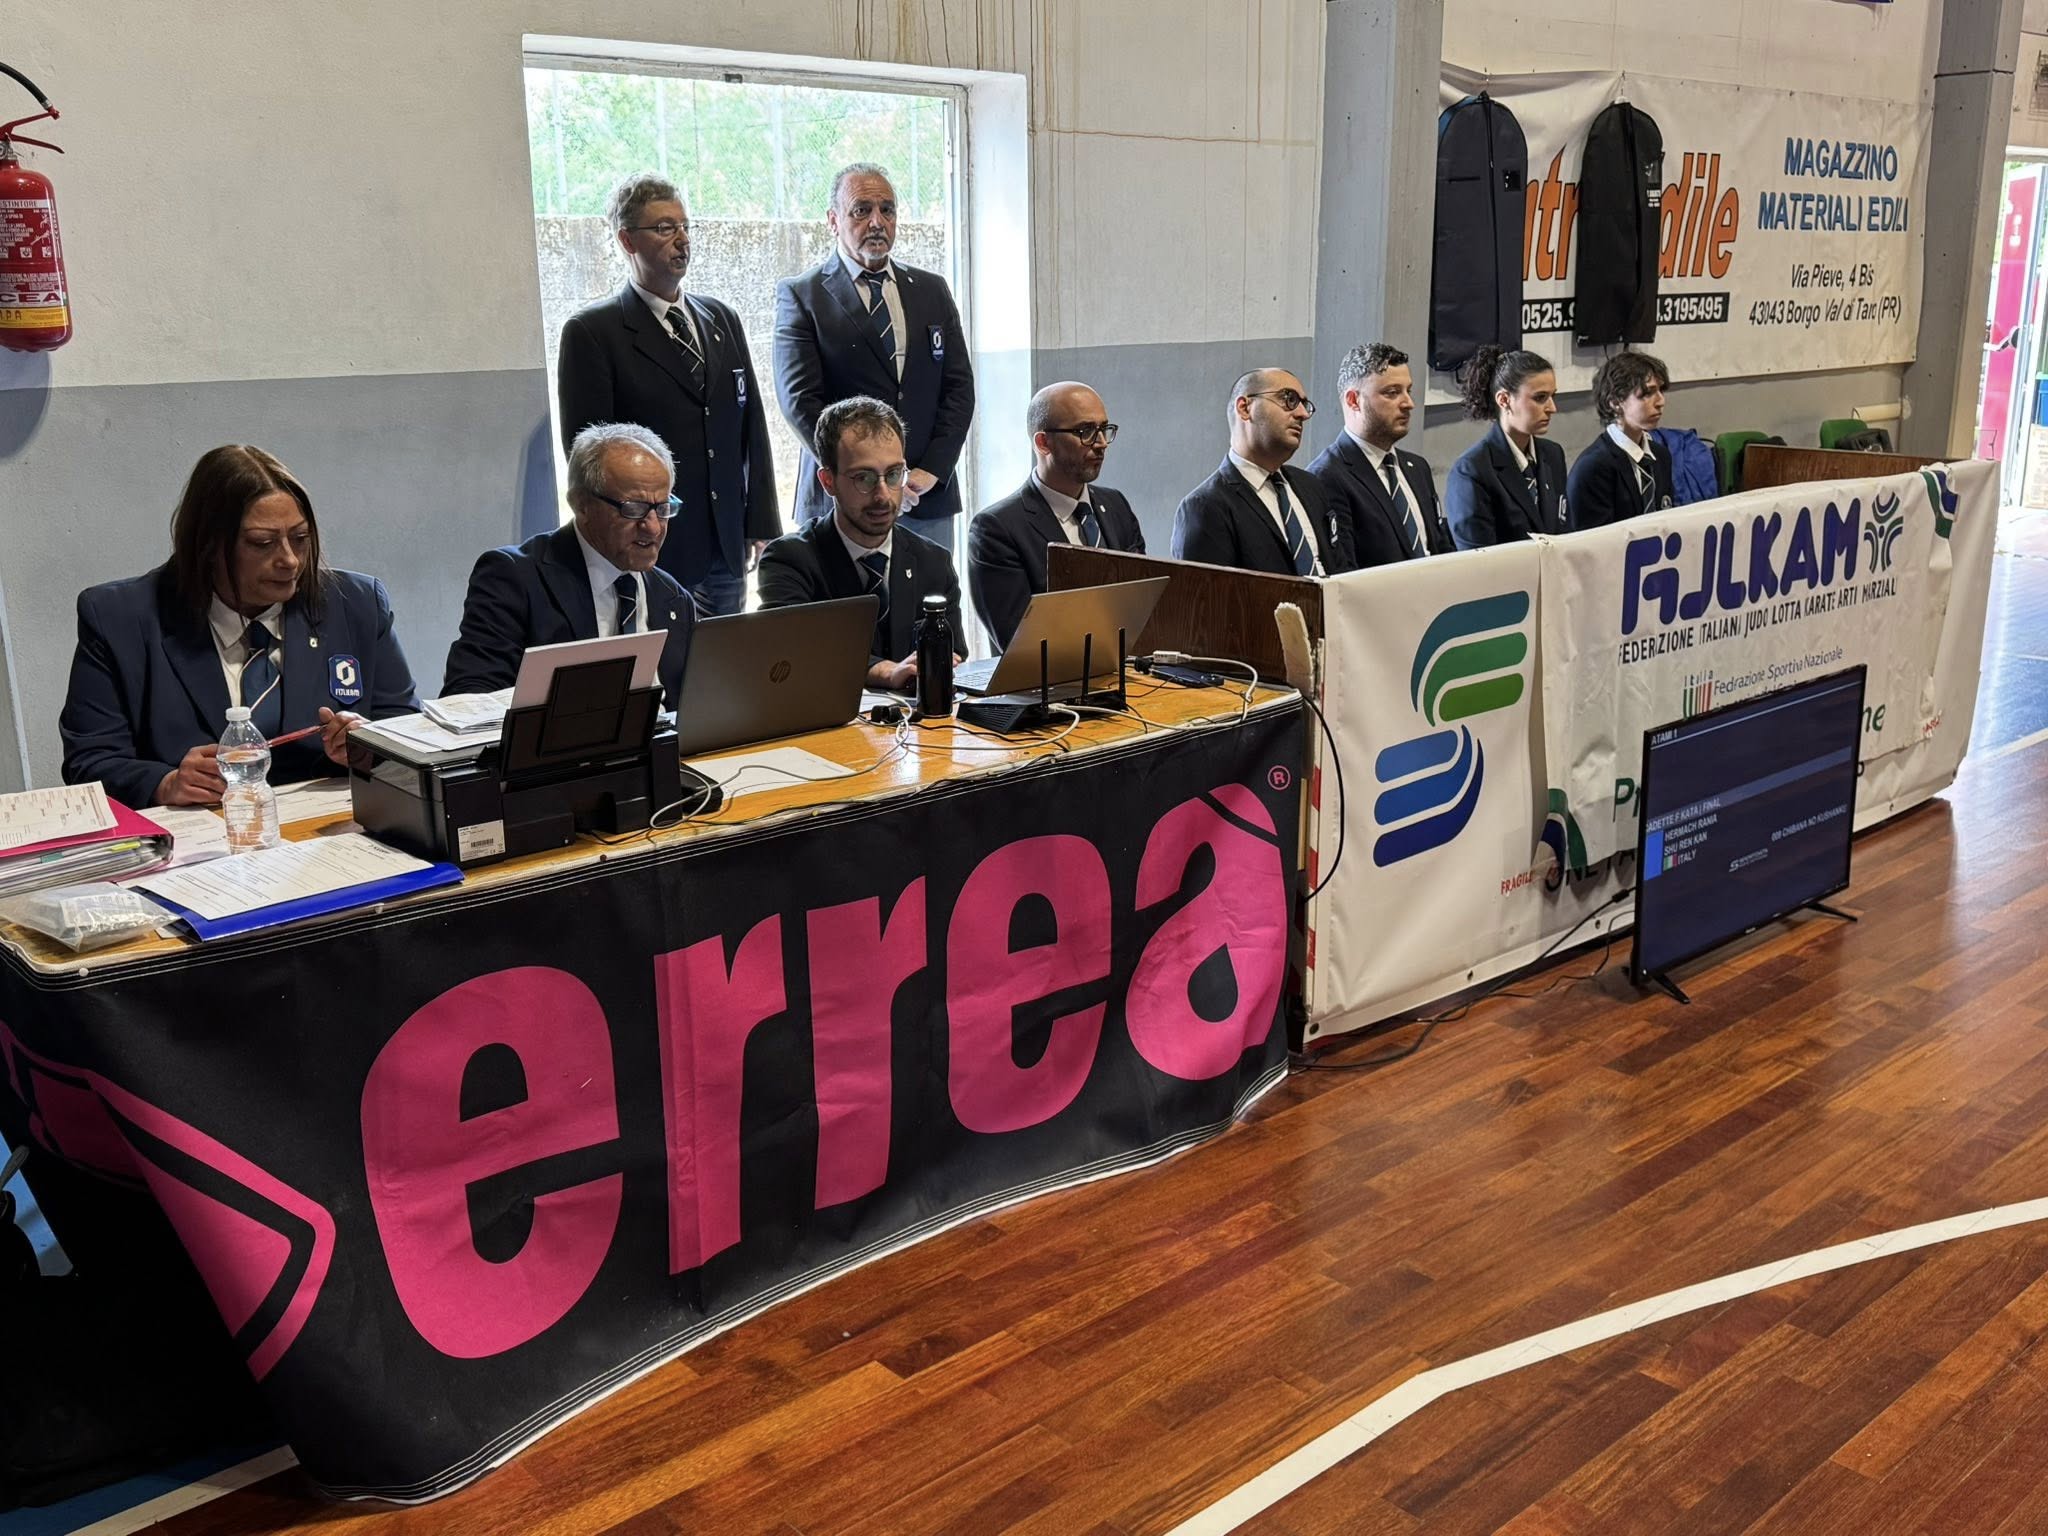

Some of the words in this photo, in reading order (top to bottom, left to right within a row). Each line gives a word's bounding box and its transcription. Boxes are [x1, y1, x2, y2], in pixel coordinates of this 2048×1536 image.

[1784, 137, 1898, 181] MAGAZZINO
[1758, 192, 1863, 231] MATERIALI
[1867, 196, 1908, 232] EDILI
[1791, 264, 1808, 288] Via
[1811, 263, 1845, 291] Pieve,
[1849, 264, 1857, 287] 4
[1859, 263, 1874, 287] Bis
[1656, 296, 1723, 323] .3195495
[1749, 301, 1785, 326] 43043
[1786, 300, 1821, 329] Borgo
[1825, 298, 1843, 322] Val
[1856, 298, 1878, 320] Taro
[1878, 295, 1902, 325] (PR)
[1618, 627, 1694, 665] FEDERZIONE
[1743, 609, 1769, 638] JUDO
[1772, 600, 1802, 625] LOTTA
[1837, 586, 1858, 609] ARTI
[1861, 578, 1898, 604] MRZIAL
[1702, 797, 1721, 812] FINAL
[1678, 850, 1697, 865] ITALY
